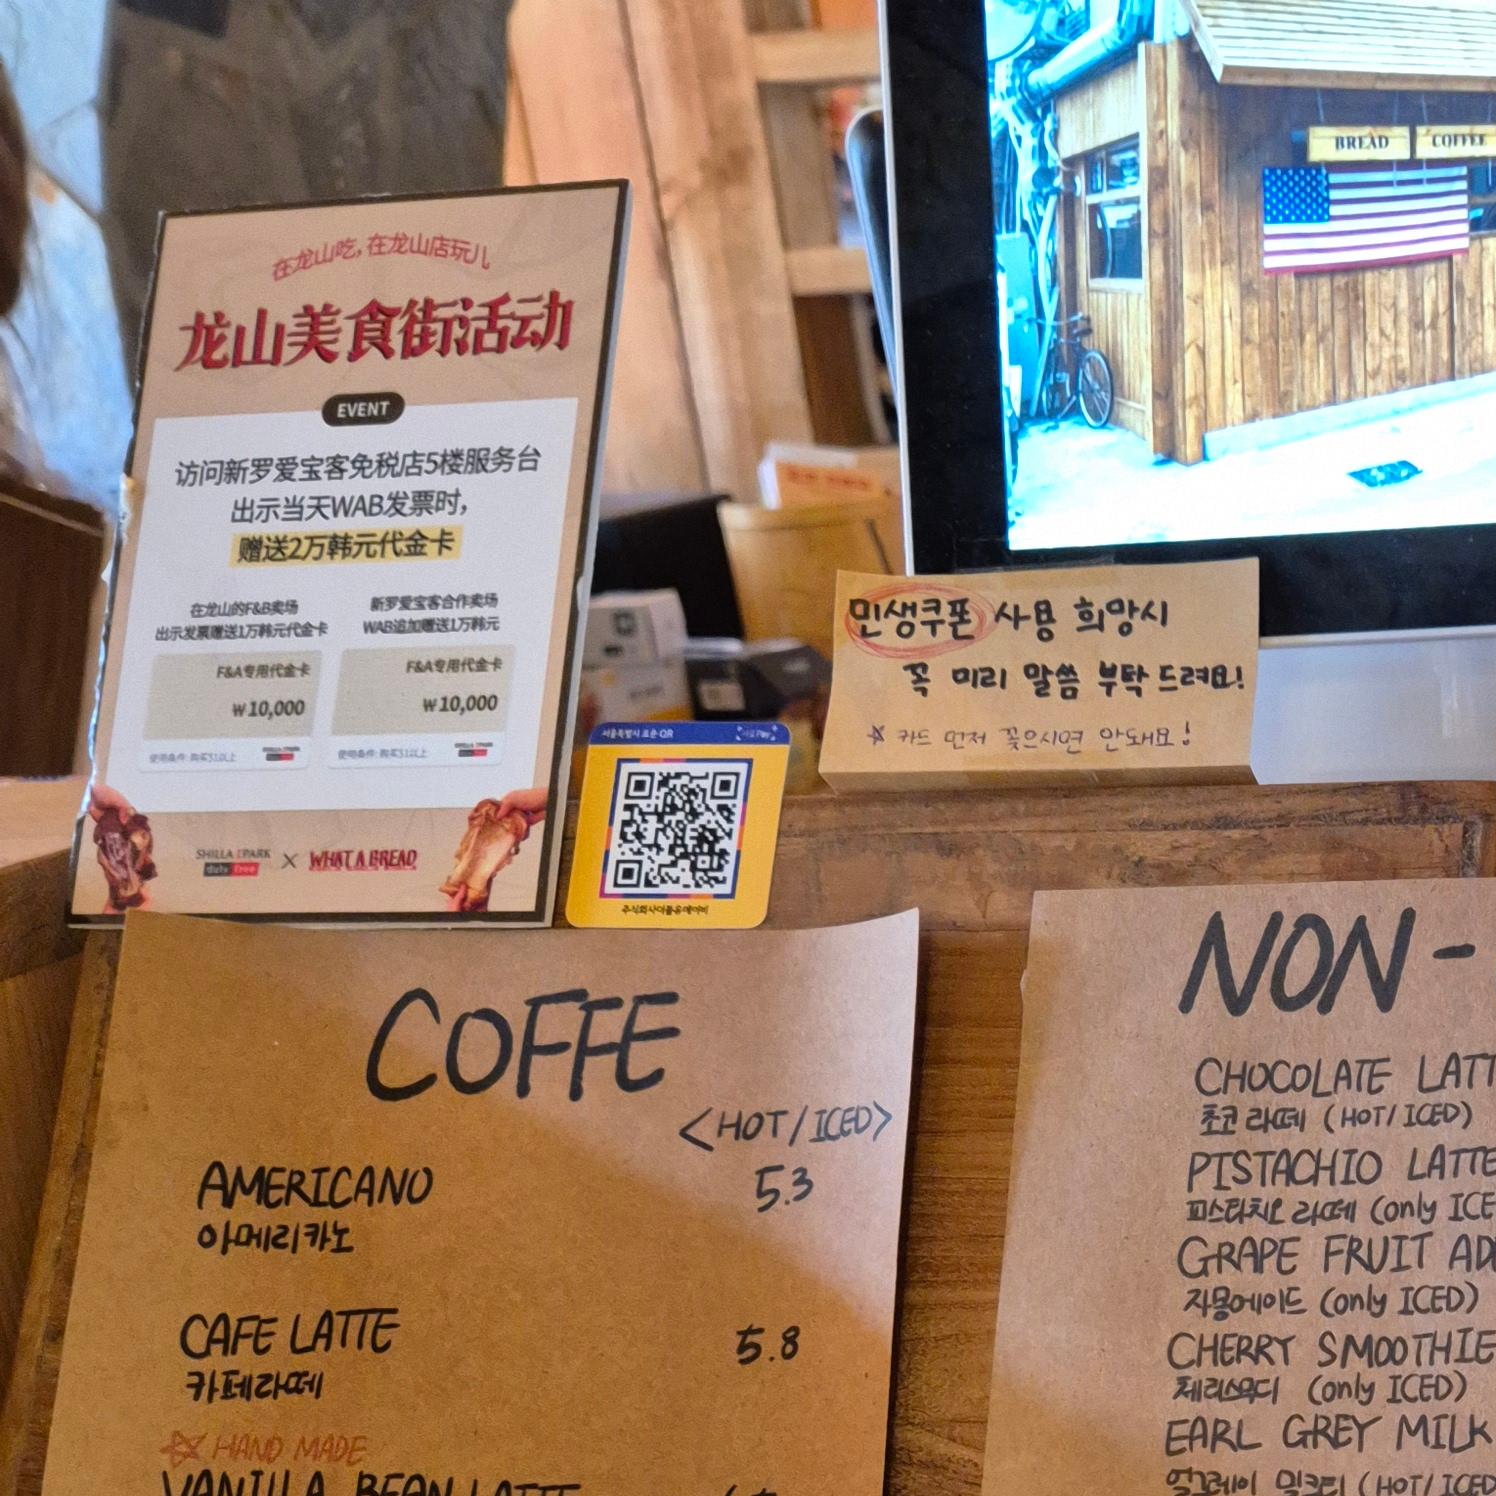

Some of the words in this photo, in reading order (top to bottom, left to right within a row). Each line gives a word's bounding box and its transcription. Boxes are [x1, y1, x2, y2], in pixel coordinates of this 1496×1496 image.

[1335, 135, 1389, 151] BREAD
[1431, 133, 1487, 149] COFFEE
[174, 289, 575, 372] 龙山美食街活动
[337, 400, 391, 419] EVENT
[174, 444, 543, 488] 访问新罗爱宝客免税店5楼服务台
[237, 528, 456, 564] 赠送2万韩元代金卡
[850, 598, 975, 640] 민생쿠폰
[995, 600, 1057, 642] 사용
[1074, 597, 1168, 637] 희망시
[216, 662, 312, 680] F&A专用代金卡
[406, 656, 503, 675] F&A专用代金卡
[903, 663, 930, 697] 꼭
[952, 664, 1007, 690] 미리
[1024, 663, 1081, 700] 말씀
[1098, 661, 1148, 697] 부탁
[897, 729, 931, 746] 카드
[944, 729, 987, 747] 먼저
[1001, 726, 1083, 755] 꽂으시면
[309, 850, 354, 868] WHAT
[369, 849, 418, 868] BREAD
[364, 987, 681, 1102] COFFE
[1195, 1056, 1392, 1098] CHOCOLATE
[1199, 1102, 1239, 1136] 초코
[1246, 1103, 1306, 1135] 라떼
[197, 1160, 433, 1210] AMERICANO
[754, 1165, 814, 1213] 5.3
[1187, 1147, 1382, 1194] PISTACHIO
[1186, 1198, 1286, 1226] 피스타치오
[1291, 1198, 1357, 1227] 라떼
[197, 1219, 354, 1256] 아메리카노
[1177, 1234, 1302, 1279] GRAPE
[1322, 1232, 1435, 1274] FRUIT
[1183, 1286, 1308, 1322] 자몽에이드
[179, 1311, 279, 1360] CAFE
[289, 1306, 400, 1357] LATTE
[736, 1323, 802, 1366] 5.8
[1167, 1331, 1297, 1372] CHERRY
[186, 1369, 325, 1404] 카페라떼
[1173, 1375, 1279, 1405] 체리스무디
[213, 1435, 284, 1464] HAND
[294, 1435, 368, 1465] MADE
[1165, 1415, 1262, 1456] EARL
[1282, 1413, 1382, 1453] GREY
[1397, 1410, 1493, 1453] MILK
